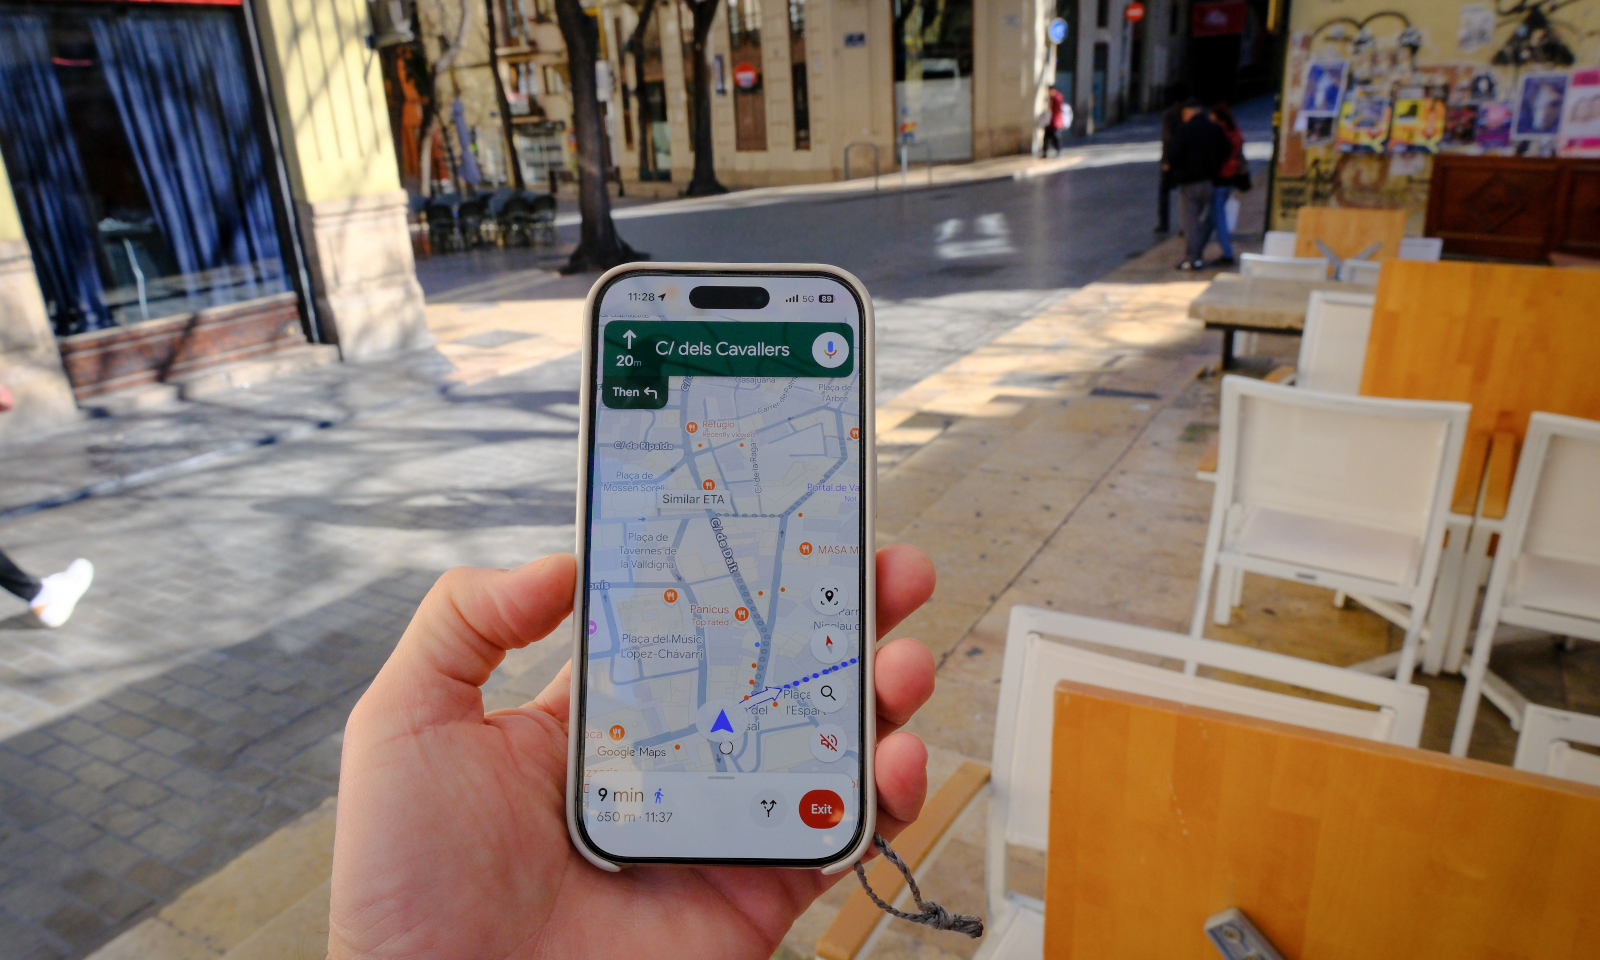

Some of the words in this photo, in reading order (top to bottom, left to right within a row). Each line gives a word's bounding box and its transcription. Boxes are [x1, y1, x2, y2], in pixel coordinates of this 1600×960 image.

[628, 292, 655, 302] 11:28
[802, 294, 815, 303] 5G
[821, 295, 833, 303] 89
[655, 340, 675, 356] C/
[678, 341, 712, 356] dels
[716, 340, 790, 357] Cavallers
[734, 376, 776, 385] Casajuana
[612, 386, 640, 397] Then
[818, 383, 840, 392] Plaça
[841, 383, 852, 391] de
[757, 402, 780, 415] Carrer
[702, 420, 735, 430] Refugio
[702, 431, 731, 439] Recently
[613, 441, 625, 450] C/
[626, 441, 639, 450] de
[640, 441, 674, 452] Ripalda
[616, 471, 640, 481] Plaça
[641, 471, 654, 480] de
[603, 483, 639, 492] Mossén
[807, 482, 834, 492] Portal
[835, 483, 847, 492] de
[662, 493, 701, 505] Similar
[703, 494, 725, 505] ETA
[628, 532, 654, 543] Plaça
[655, 533, 669, 542] de
[715, 532, 728, 548] de
[619, 545, 662, 555] Tavernes
[664, 546, 677, 556] de
[818, 545, 847, 555] MASA
[620, 560, 629, 569] la
[631, 559, 675, 571] Valldigna
[721, 547, 739, 574] Dalt
[690, 604, 730, 615] Panicus
[692, 618, 708, 627] Top
[707, 618, 730, 626] rated
[622, 633, 651, 646] Plaça
[652, 634, 669, 644] del
[671, 633, 703, 645] Músic
[620, 648, 704, 661] López-Chávarri
[751, 704, 768, 716] del
[597, 746, 636, 759] Google
[639, 747, 667, 759] Maps
[598, 787, 608, 802] 9
[613, 787, 644, 803] min
[811, 803, 833, 815] Exit
[597, 811, 621, 822] 650
[624, 813, 636, 822] m
[645, 812, 673, 823] 11:37
